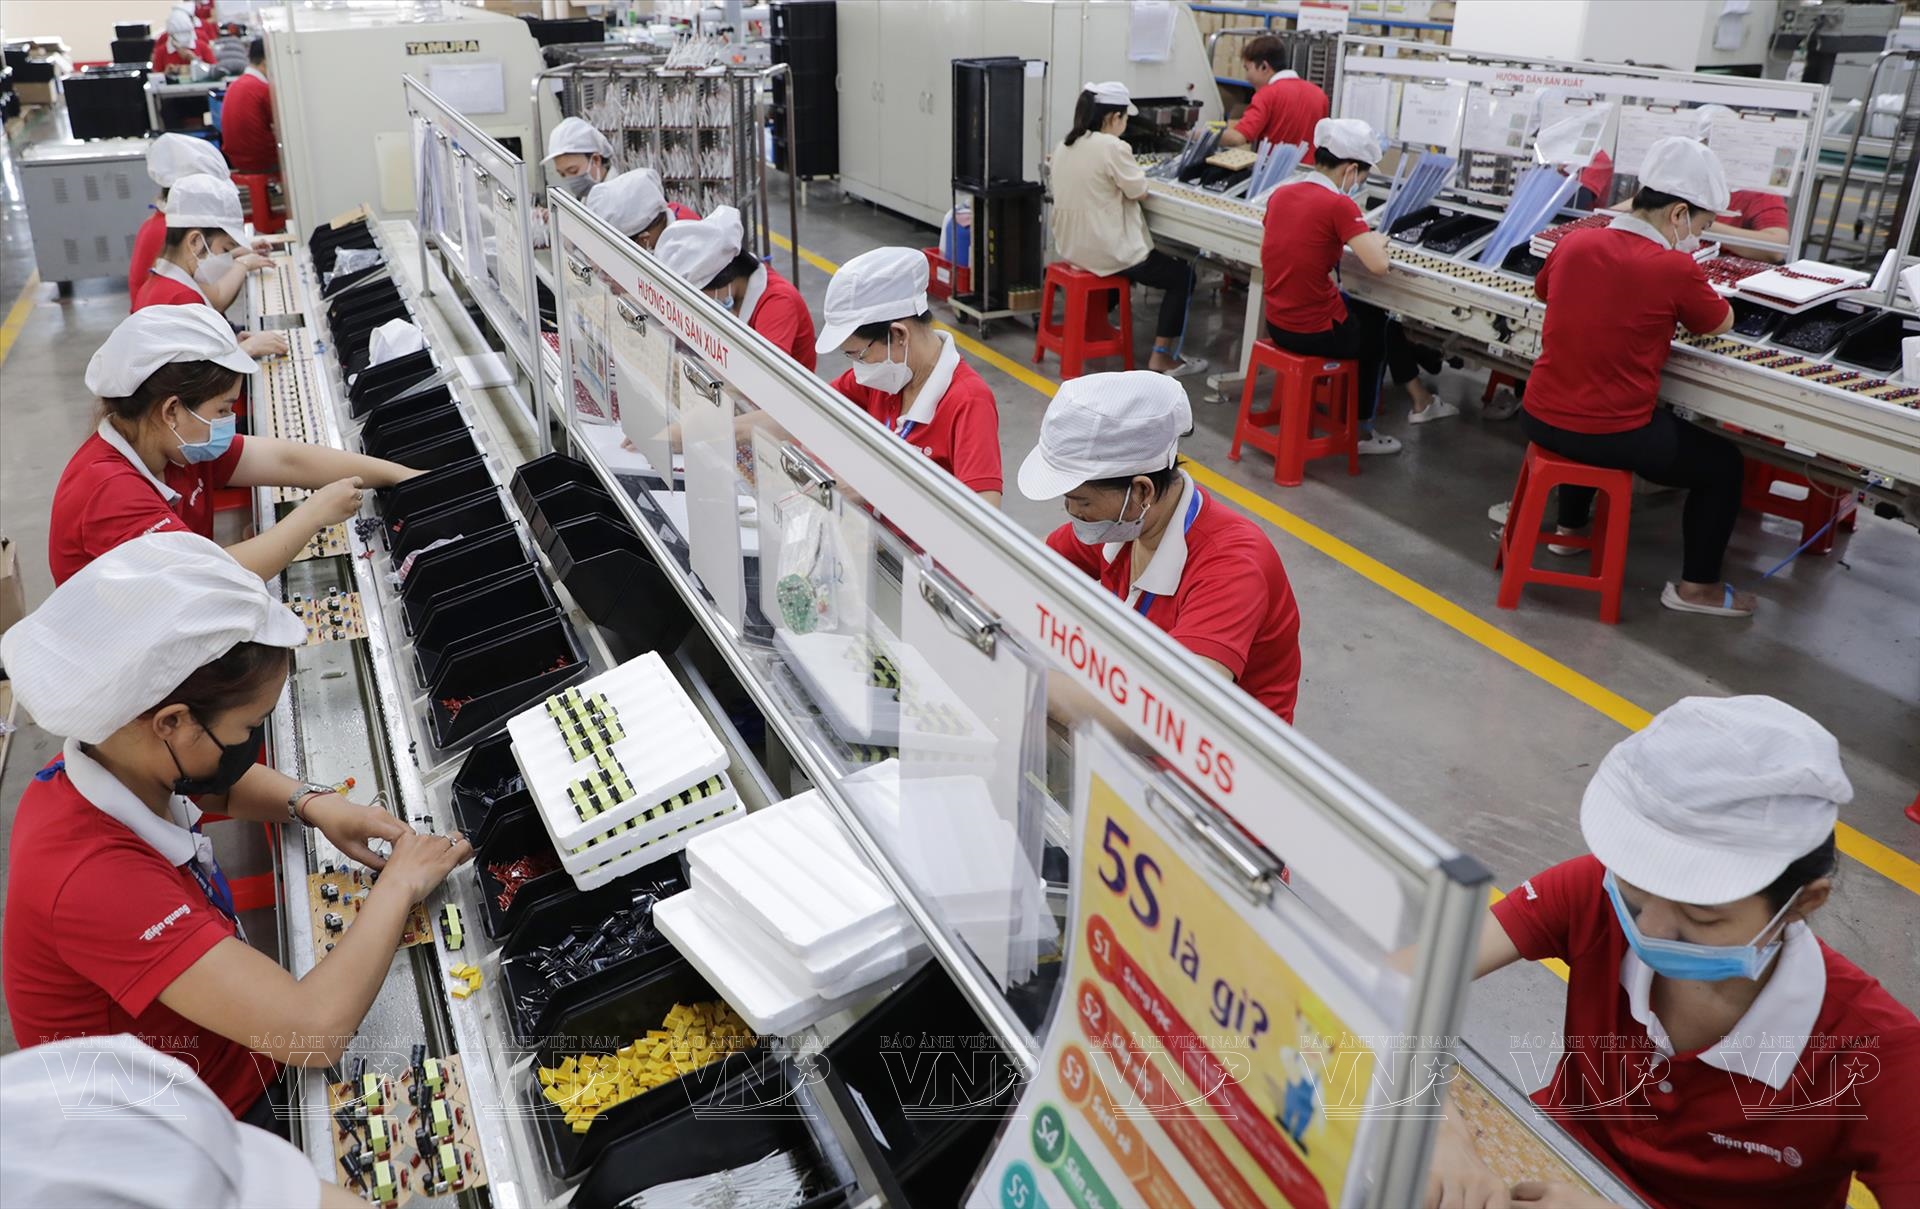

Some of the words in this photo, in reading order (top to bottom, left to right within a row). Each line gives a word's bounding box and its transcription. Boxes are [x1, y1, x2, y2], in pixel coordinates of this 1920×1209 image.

[406, 40, 480, 55] TAMURA
[638, 276, 665, 315] HƯỚNG
[685, 316, 703, 348] SẢN
[704, 331, 729, 369] XUẤT
[1036, 602, 1128, 705] THÔNG
[1139, 685, 1185, 755] TIN
[1196, 737, 1234, 794] 5S
[1099, 816, 1161, 930] 5S
[1092, 929, 1110, 965] S1
[1169, 915, 1200, 984] là
[1210, 977, 1269, 1050] gì?
[1082, 992, 1102, 1030] S2
[1064, 1054, 1084, 1090] S3
[1036, 1115, 1058, 1152] S4
[1743, 1141, 1782, 1163] quang
[1007, 1173, 1028, 1209] S5
